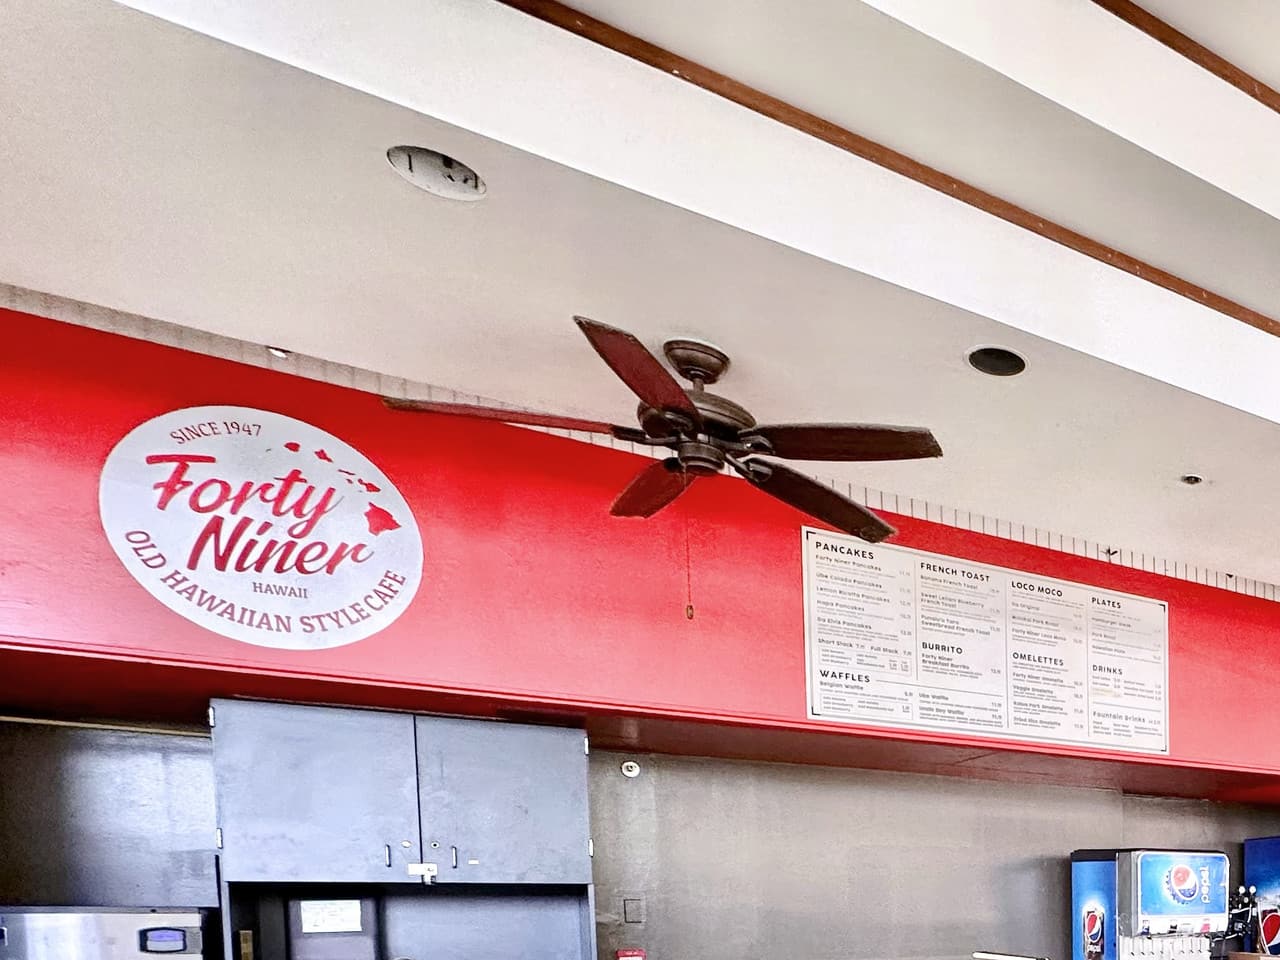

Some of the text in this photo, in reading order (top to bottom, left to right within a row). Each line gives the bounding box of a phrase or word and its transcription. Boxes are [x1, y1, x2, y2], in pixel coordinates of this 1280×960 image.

[168, 420, 263, 445] SINCE 1947
[145, 454, 345, 540] Forty
[186, 515, 375, 576] Niner
[815, 541, 875, 560] PANCAKES
[124, 529, 407, 634] OLD HAWAIIAN STYLE CAFE
[920, 562, 958, 576] FRENCH
[961, 570, 991, 583] TOAST
[251, 581, 309, 600] HAWAII
[1011, 580, 1063, 597] LOCO MOCO
[1091, 597, 1122, 609] PLATES
[922, 641, 963, 655] BURRITO
[1012, 652, 1064, 666] OMELETTES
[819, 669, 871, 683] WAFFLES
[1092, 664, 1123, 675] DRINKS
